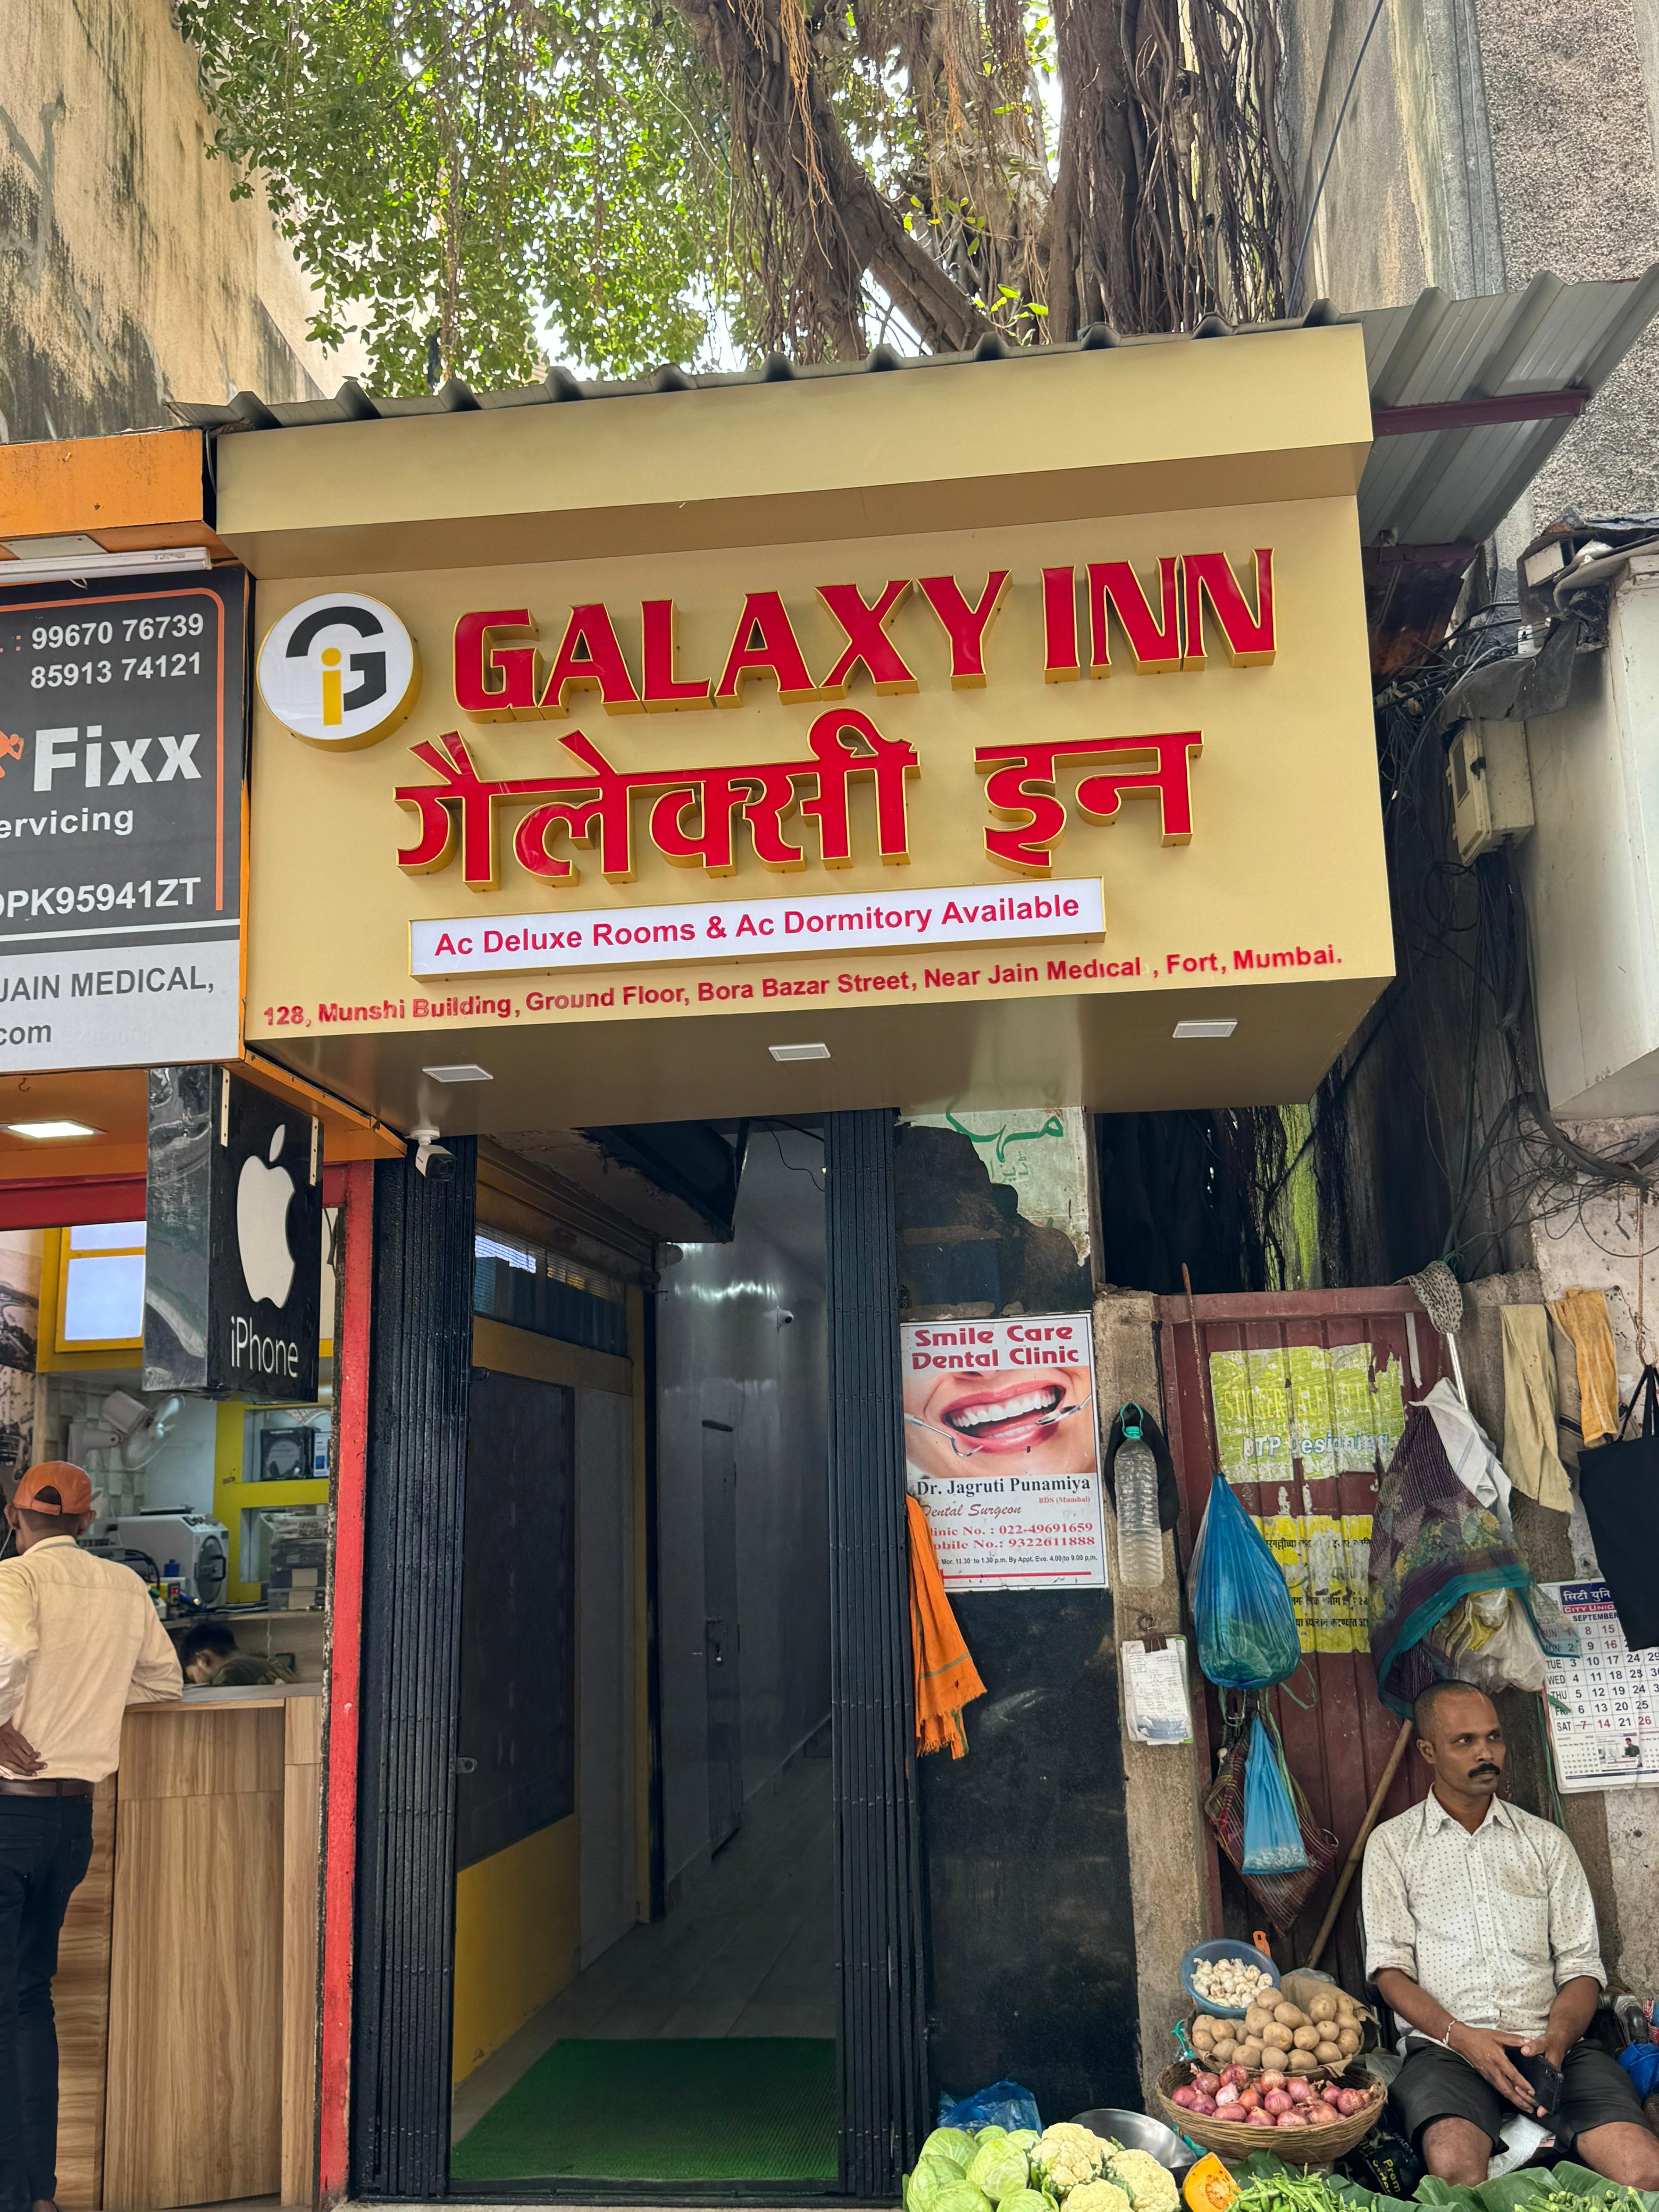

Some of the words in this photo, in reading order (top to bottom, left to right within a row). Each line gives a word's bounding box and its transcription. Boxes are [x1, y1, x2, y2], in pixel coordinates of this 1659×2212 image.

[32, 621, 113, 650] 99670
[122, 613, 204, 642] 76739
[453, 568, 1012, 719] GALAXY
[1041, 548, 1275, 678] INN
[30, 660, 112, 689] 85913
[121, 651, 200, 681] 74121
[33, 725, 202, 792] Fixx
[392, 707, 921, 887] गैलेक्सी
[973, 730, 1204, 873] इन
[0, 807, 133, 839] ervicing
[0, 877, 201, 918] PK95941ZT
[434, 933, 473, 956] Ac
[483, 928, 582, 953] Deluxe
[593, 922, 696, 946] Rooms
[706, 916, 727, 939] &
[735, 914, 774, 937] Ac
[784, 906, 933, 933] Dormitory
[941, 894, 1079, 924] Available
[71, 966, 214, 997] MEDICAL,
[264, 1006, 311, 1027] 128,
[319, 999, 405, 1023] Munshi
[413, 995, 520, 1018] Building,
[526, 987, 615, 1011] Ground
[623, 985, 690, 1006] Floor,
[698, 982, 753, 1002] Bora
[762, 978, 830, 998] Bazar
[837, 971, 917, 993] Street,
[925, 968, 980, 988] Near
[988, 962, 1038, 984] Jain
[1047, 957, 1141, 980] Medical
[1166, 953, 1227, 975] Fort,
[1233, 944, 1342, 970] Mumbai.
[231, 1316, 298, 1378] iPhone
[915, 1328, 994, 1347] Smile
[1007, 1325, 1073, 1342] Care
[912, 1349, 999, 1370] Dental
[1009, 1346, 1079, 1365] Clinic
[1243, 1436, 1282, 1459] DTP
[917, 1481, 942, 1495] Dr.
[947, 1478, 1004, 1497] Jagruti
[1010, 1476, 1090, 1493] Punamiya
[921, 1504, 963, 1516] Dental
[968, 1504, 1021, 1519] Surgeon
[931, 1527, 958, 1536] linic
[999, 1522, 1093, 1536] 022-49691659
[934, 1540, 968, 1549] obile
[1008, 1536, 1095, 1547] 9322611888
[1563, 1589, 1587, 1602] सिटी
[1590, 1587, 1611, 1602] युनि
[1573, 1613, 1619, 1622] SEPTEMBER
[1585, 1626, 1591, 1635] 8
[1602, 1624, 1614, 1633] 15
[1568, 1643, 1574, 1652] 2
[1587, 1642, 1594, 1650] 9
[1604, 1640, 1618, 1649] 16
[1546, 1660, 1562, 1669] TUE
[1570, 1658, 1577, 1667] 3
[1587, 1657, 1599, 1666] 10
[1607, 1655, 1619, 1665] 17
[1627, 1654, 1640, 1663] 24
[1547, 1675, 1565, 1685] WED
[1572, 1674, 1579, 1682] 4
[1590, 1672, 1602, 1681] 11
[1610, 1671, 1623, 1680] 18
[1576, 1689, 1581, 1698] 5
[1592, 1688, 1605, 1697] 12
[1612, 1686, 1625, 1696] 19
[1632, 1685, 1645, 1694] 24
[1578, 1705, 1585, 1714] 6
[1595, 1703, 1608, 1712] 13
[1615, 1702, 1628, 1711] 20
[1635, 1700, 1649, 1710] 25
[1557, 1722, 1571, 1731] SAT
[1580, 1720, 1587, 1729] 7
[1597, 1719, 1611, 1728] 14
[1618, 1717, 1631, 1727] 21
[1638, 1716, 1651, 1725] 26
